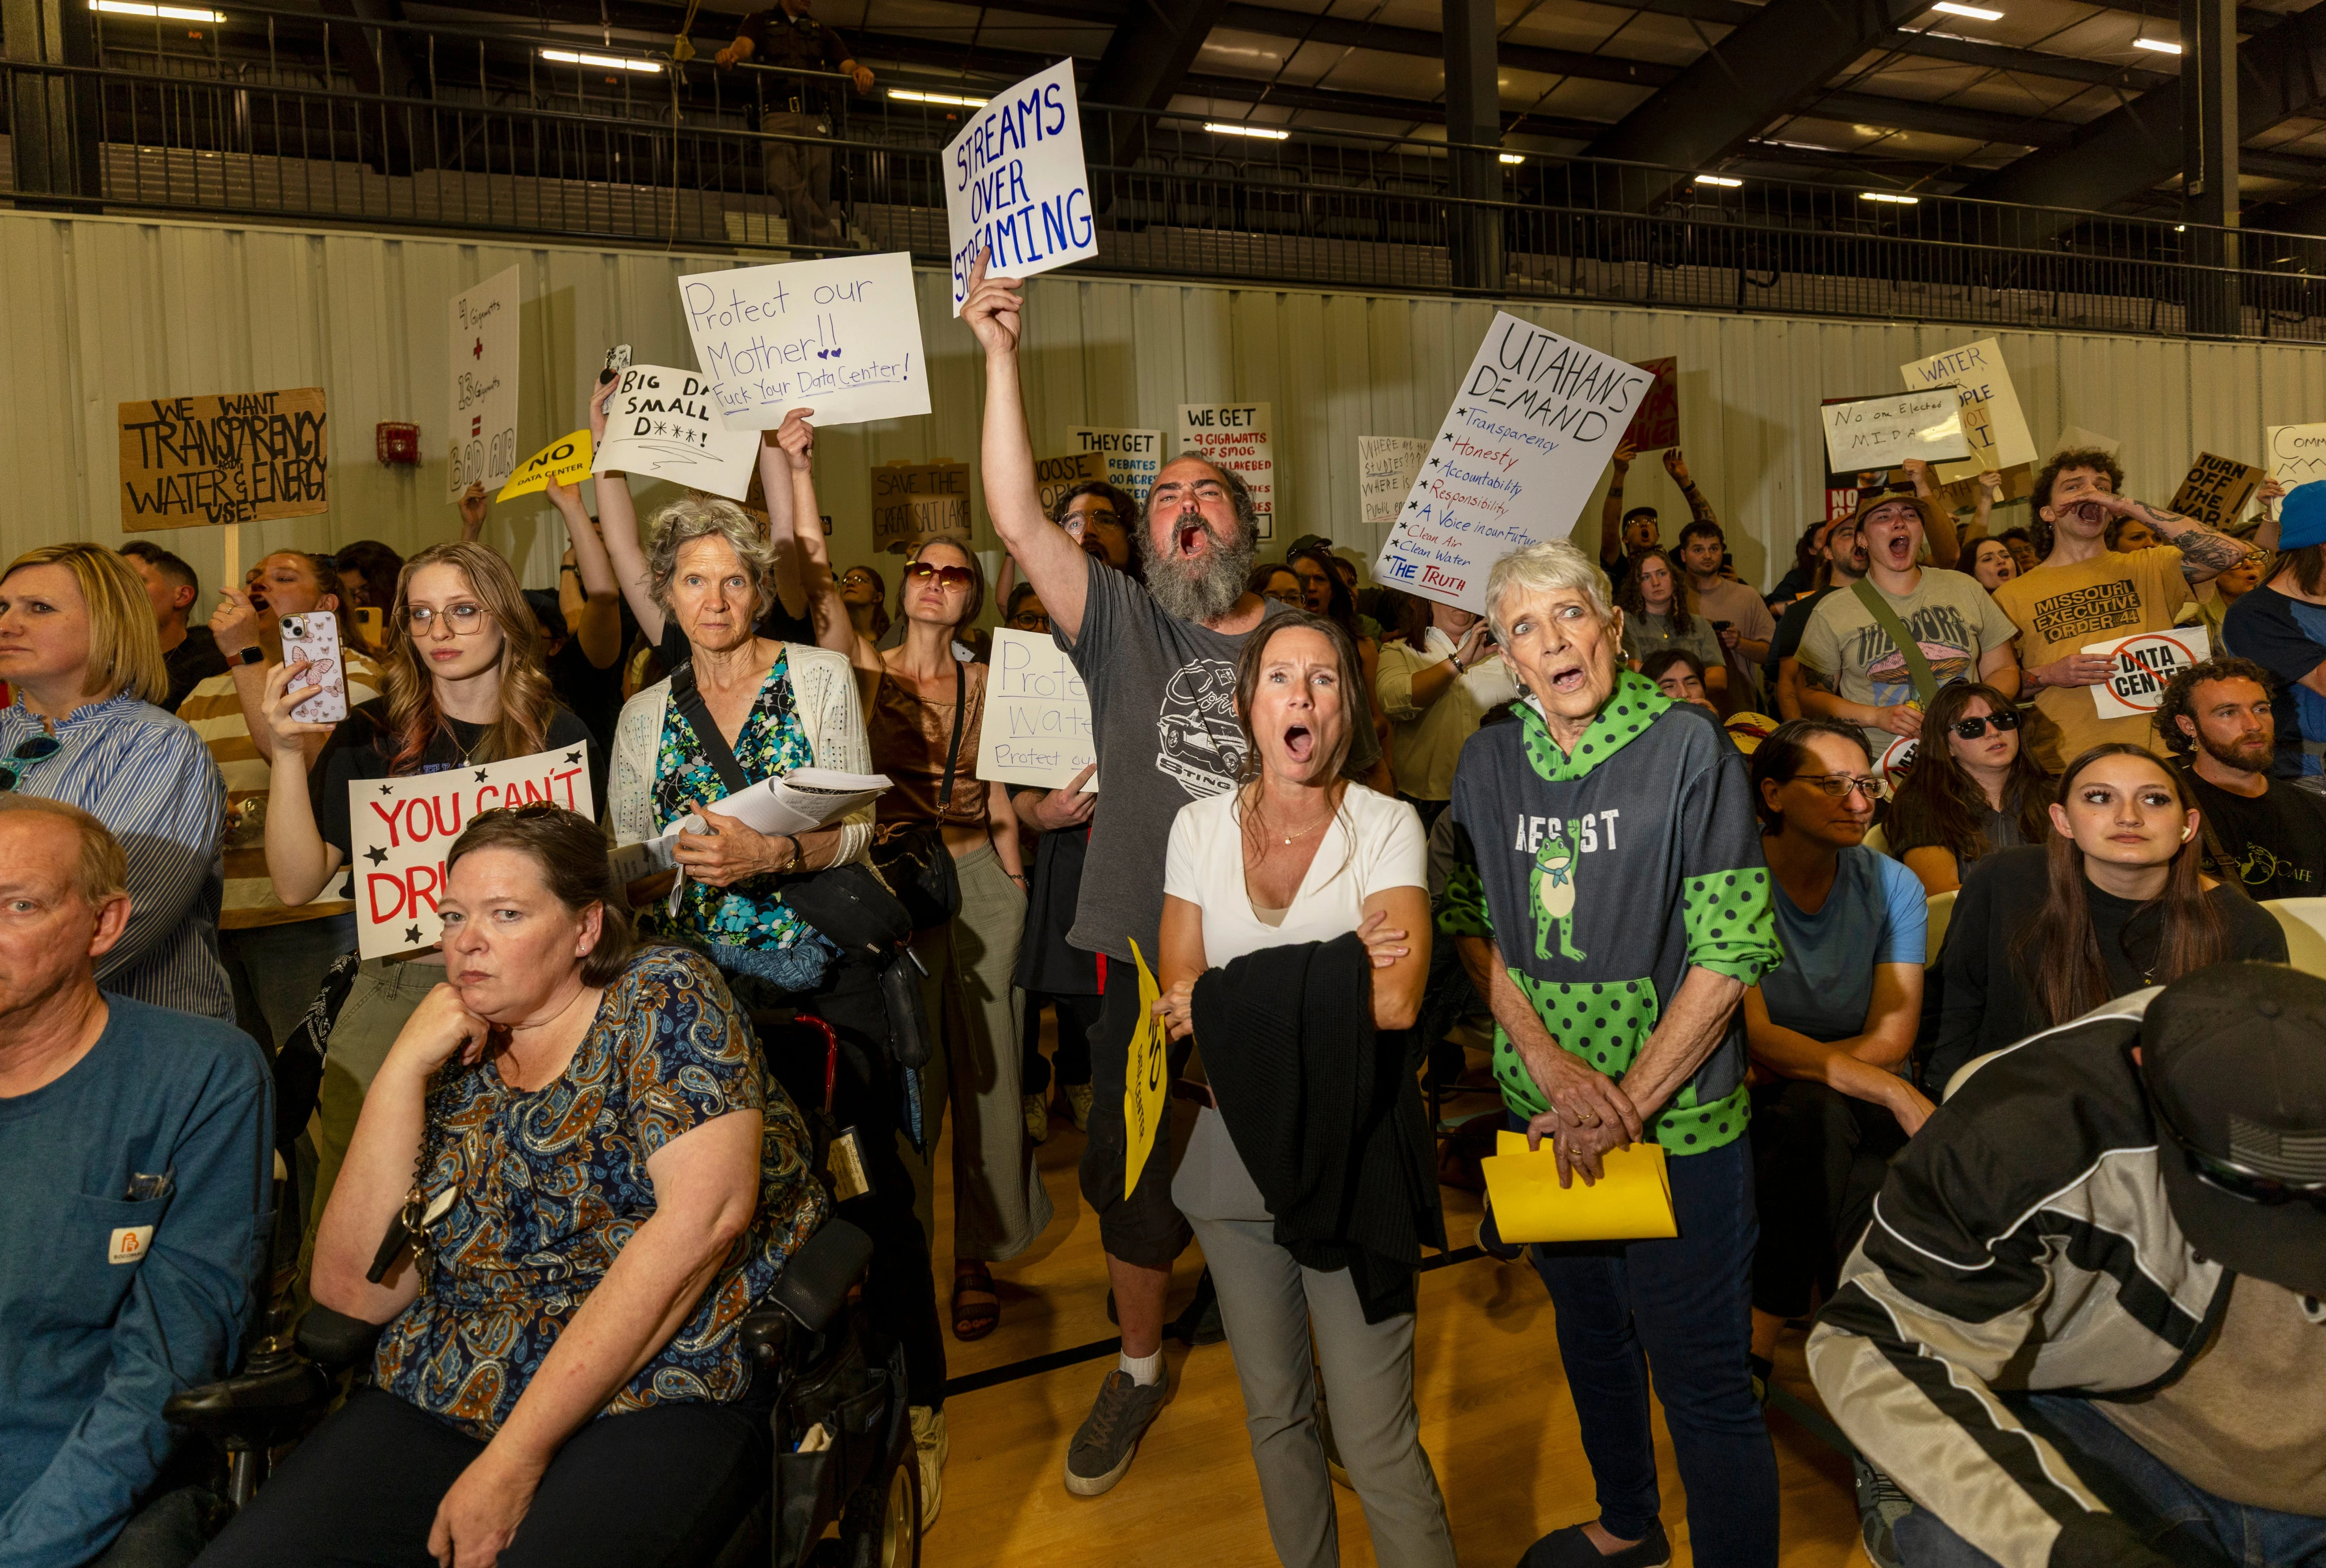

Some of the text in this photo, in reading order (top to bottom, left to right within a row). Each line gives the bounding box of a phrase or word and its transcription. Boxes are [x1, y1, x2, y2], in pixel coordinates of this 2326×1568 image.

[957, 82, 1065, 192] STREAMS
[971, 159, 1030, 224] OVER
[459, 298, 500, 330] 4 Gigawatts
[685, 280, 873, 332] Protect our
[1499, 322, 1643, 413] UTAHANS
[1918, 347, 1988, 382] WATER
[458, 372, 500, 410] 13 Gigawatts
[621, 370, 660, 395] BIG
[713, 353, 909, 407] Fuck Your Data Center!
[152, 392, 279, 421] WE WANT
[625, 396, 710, 421] SMALL
[1187, 408, 1256, 426] WE GET
[1468, 365, 1608, 442] DEMAND
[1835, 401, 1942, 426] No one Elected
[124, 410, 326, 469] TRANSPARENCY
[1077, 432, 1154, 452] THEY GET
[1206, 433, 1267, 445] GIGAWATTS
[1465, 407, 1559, 455] Transparency
[1852, 428, 1916, 448] MIDA
[450, 428, 514, 492] BAD AIR
[528, 443, 574, 472] NO
[1200, 446, 1255, 458] OF SMOG
[1360, 438, 1428, 460] WHERE are the
[1452, 435, 1519, 472] Honesty
[517, 462, 584, 487] DATA CENTER
[1108, 458, 1156, 470] REBATES
[1229, 460, 1271, 471] LAKEBED
[2199, 455, 2249, 479] TURN
[126, 469, 235, 515] WATER
[252, 456, 327, 503] ENERGY
[877, 471, 964, 496] SAVE THE
[1362, 478, 1398, 497] WHERE
[1437, 460, 1522, 501] Accountability
[2187, 468, 2233, 493] OFF
[205, 499, 258, 523] USE!
[1429, 479, 1509, 520] Responsibility
[1832, 489, 1858, 508] NO
[2186, 485, 2224, 510] THE
[874, 500, 972, 537] GREAT SALT LAKE
[1416, 504, 1431, 522] A
[1439, 509, 1471, 531] Voice
[2173, 499, 2221, 527] WAR
[1407, 525, 1462, 548] Clean Air
[1399, 540, 1471, 566] Clean Water
[1390, 555, 1466, 592] THE TRUTH
[2036, 581, 2130, 615] MISSOURI
[2036, 593, 2139, 631] EXECUTIVE
[2048, 611, 2139, 642] ORDER 44
[2120, 645, 2175, 673] DATA
[995, 744, 1061, 765] Protect
[1160, 757, 1231, 790] STING
[370, 792, 461, 848] YOU
